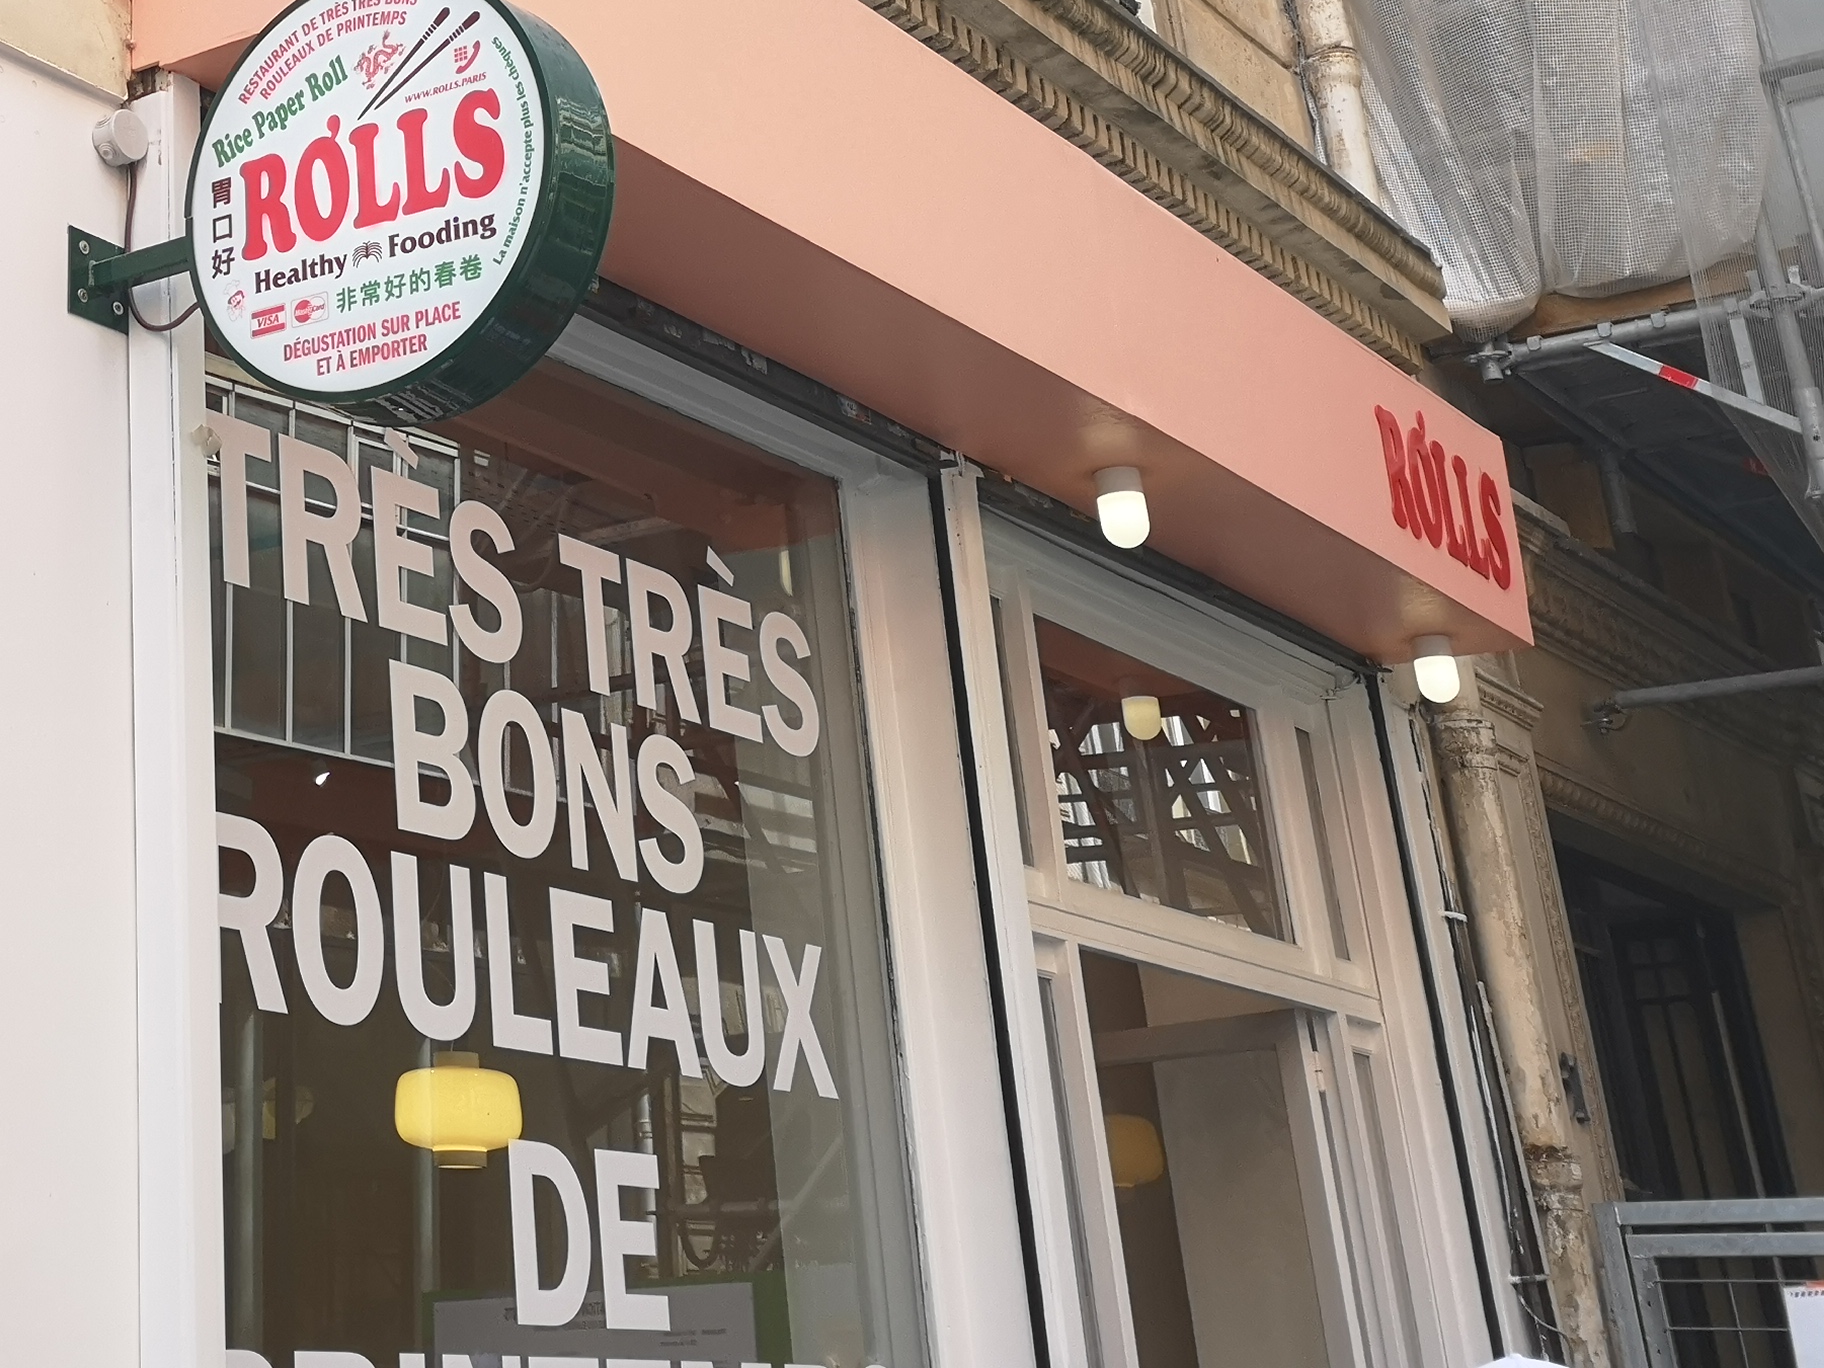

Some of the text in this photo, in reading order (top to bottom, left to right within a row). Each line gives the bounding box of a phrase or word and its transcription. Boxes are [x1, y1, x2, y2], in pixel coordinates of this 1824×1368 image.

[238, 30, 300, 105] RESTAURANT
[301, 17, 319, 37] DE
[319, 1, 350, 26] TRÈS
[259, 10, 408, 101] ROULEAUX DE PRINTEMPS
[491, 36, 520, 82] chèques
[211, 53, 349, 168] Rice Paper Roll
[404, 71, 487, 104] WWW.ROLLS.PARIS
[515, 81, 527, 101] les
[520, 100, 534, 129] plus
[254, 212, 497, 294] Healthy Fooding
[503, 198, 526, 250] maison
[492, 249, 508, 266] La
[256, 314, 281, 329] VISA
[283, 301, 462, 362] DÉGUSTATION SUR PLACE
[316, 333, 428, 376] ET À EMPORTER
[207, 410, 821, 757] TRÈS TRÈS
[389, 658, 705, 894] BONS
[216, 811, 839, 1100] ROULEAUX
[507, 1138, 671, 1331] DE
